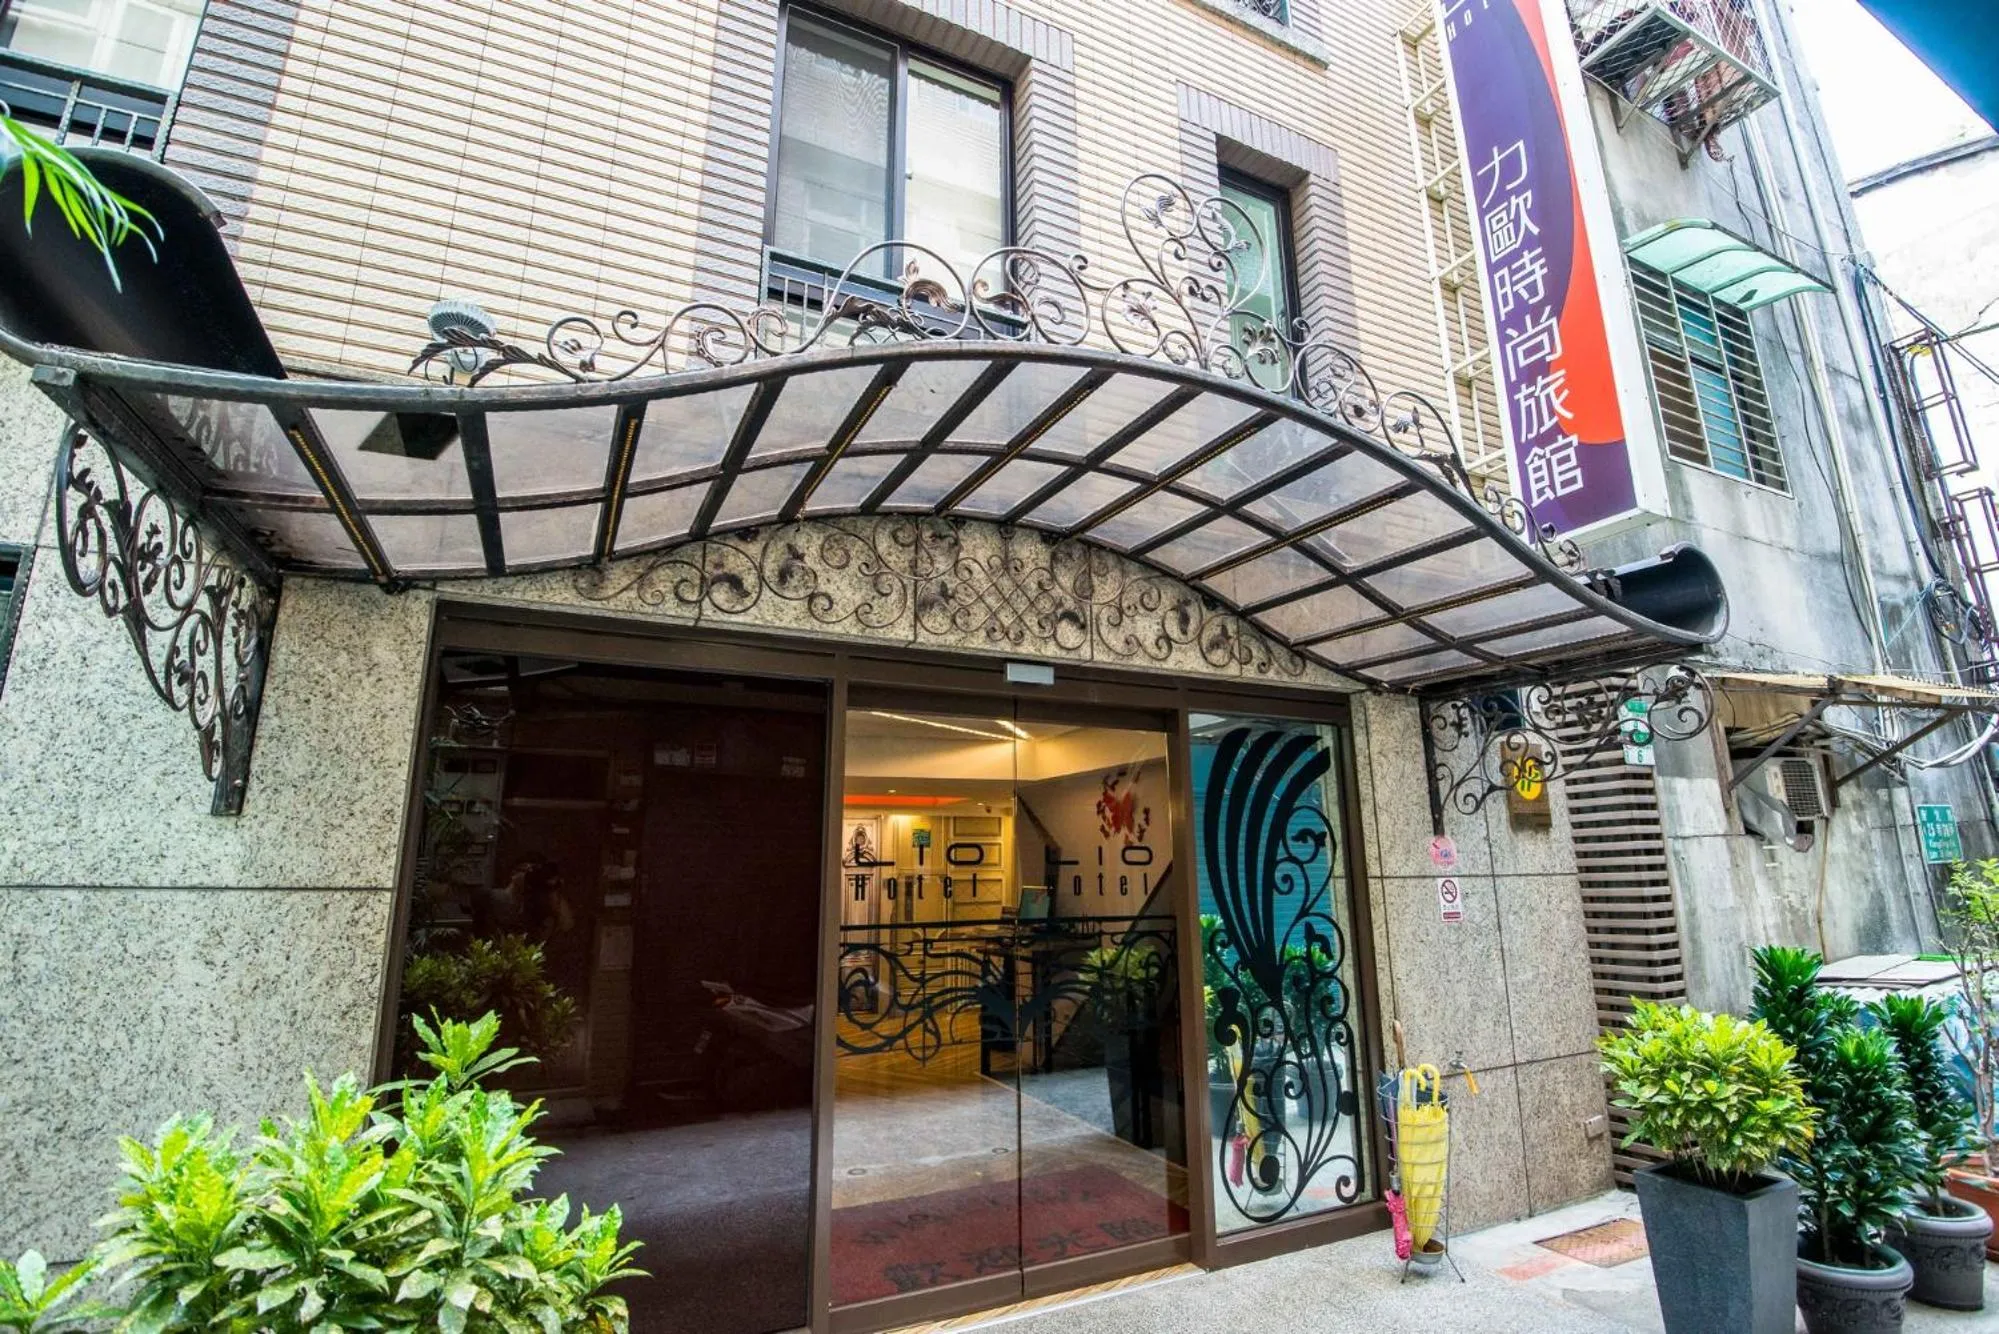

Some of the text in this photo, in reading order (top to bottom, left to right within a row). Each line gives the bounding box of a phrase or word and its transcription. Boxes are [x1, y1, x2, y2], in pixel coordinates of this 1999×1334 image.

[1477, 138, 1584, 509] 力歐時尚旅館
[854, 842, 985, 867] LIO
[854, 872, 978, 901] Hotel
[1047, 872, 1148, 897] otel
